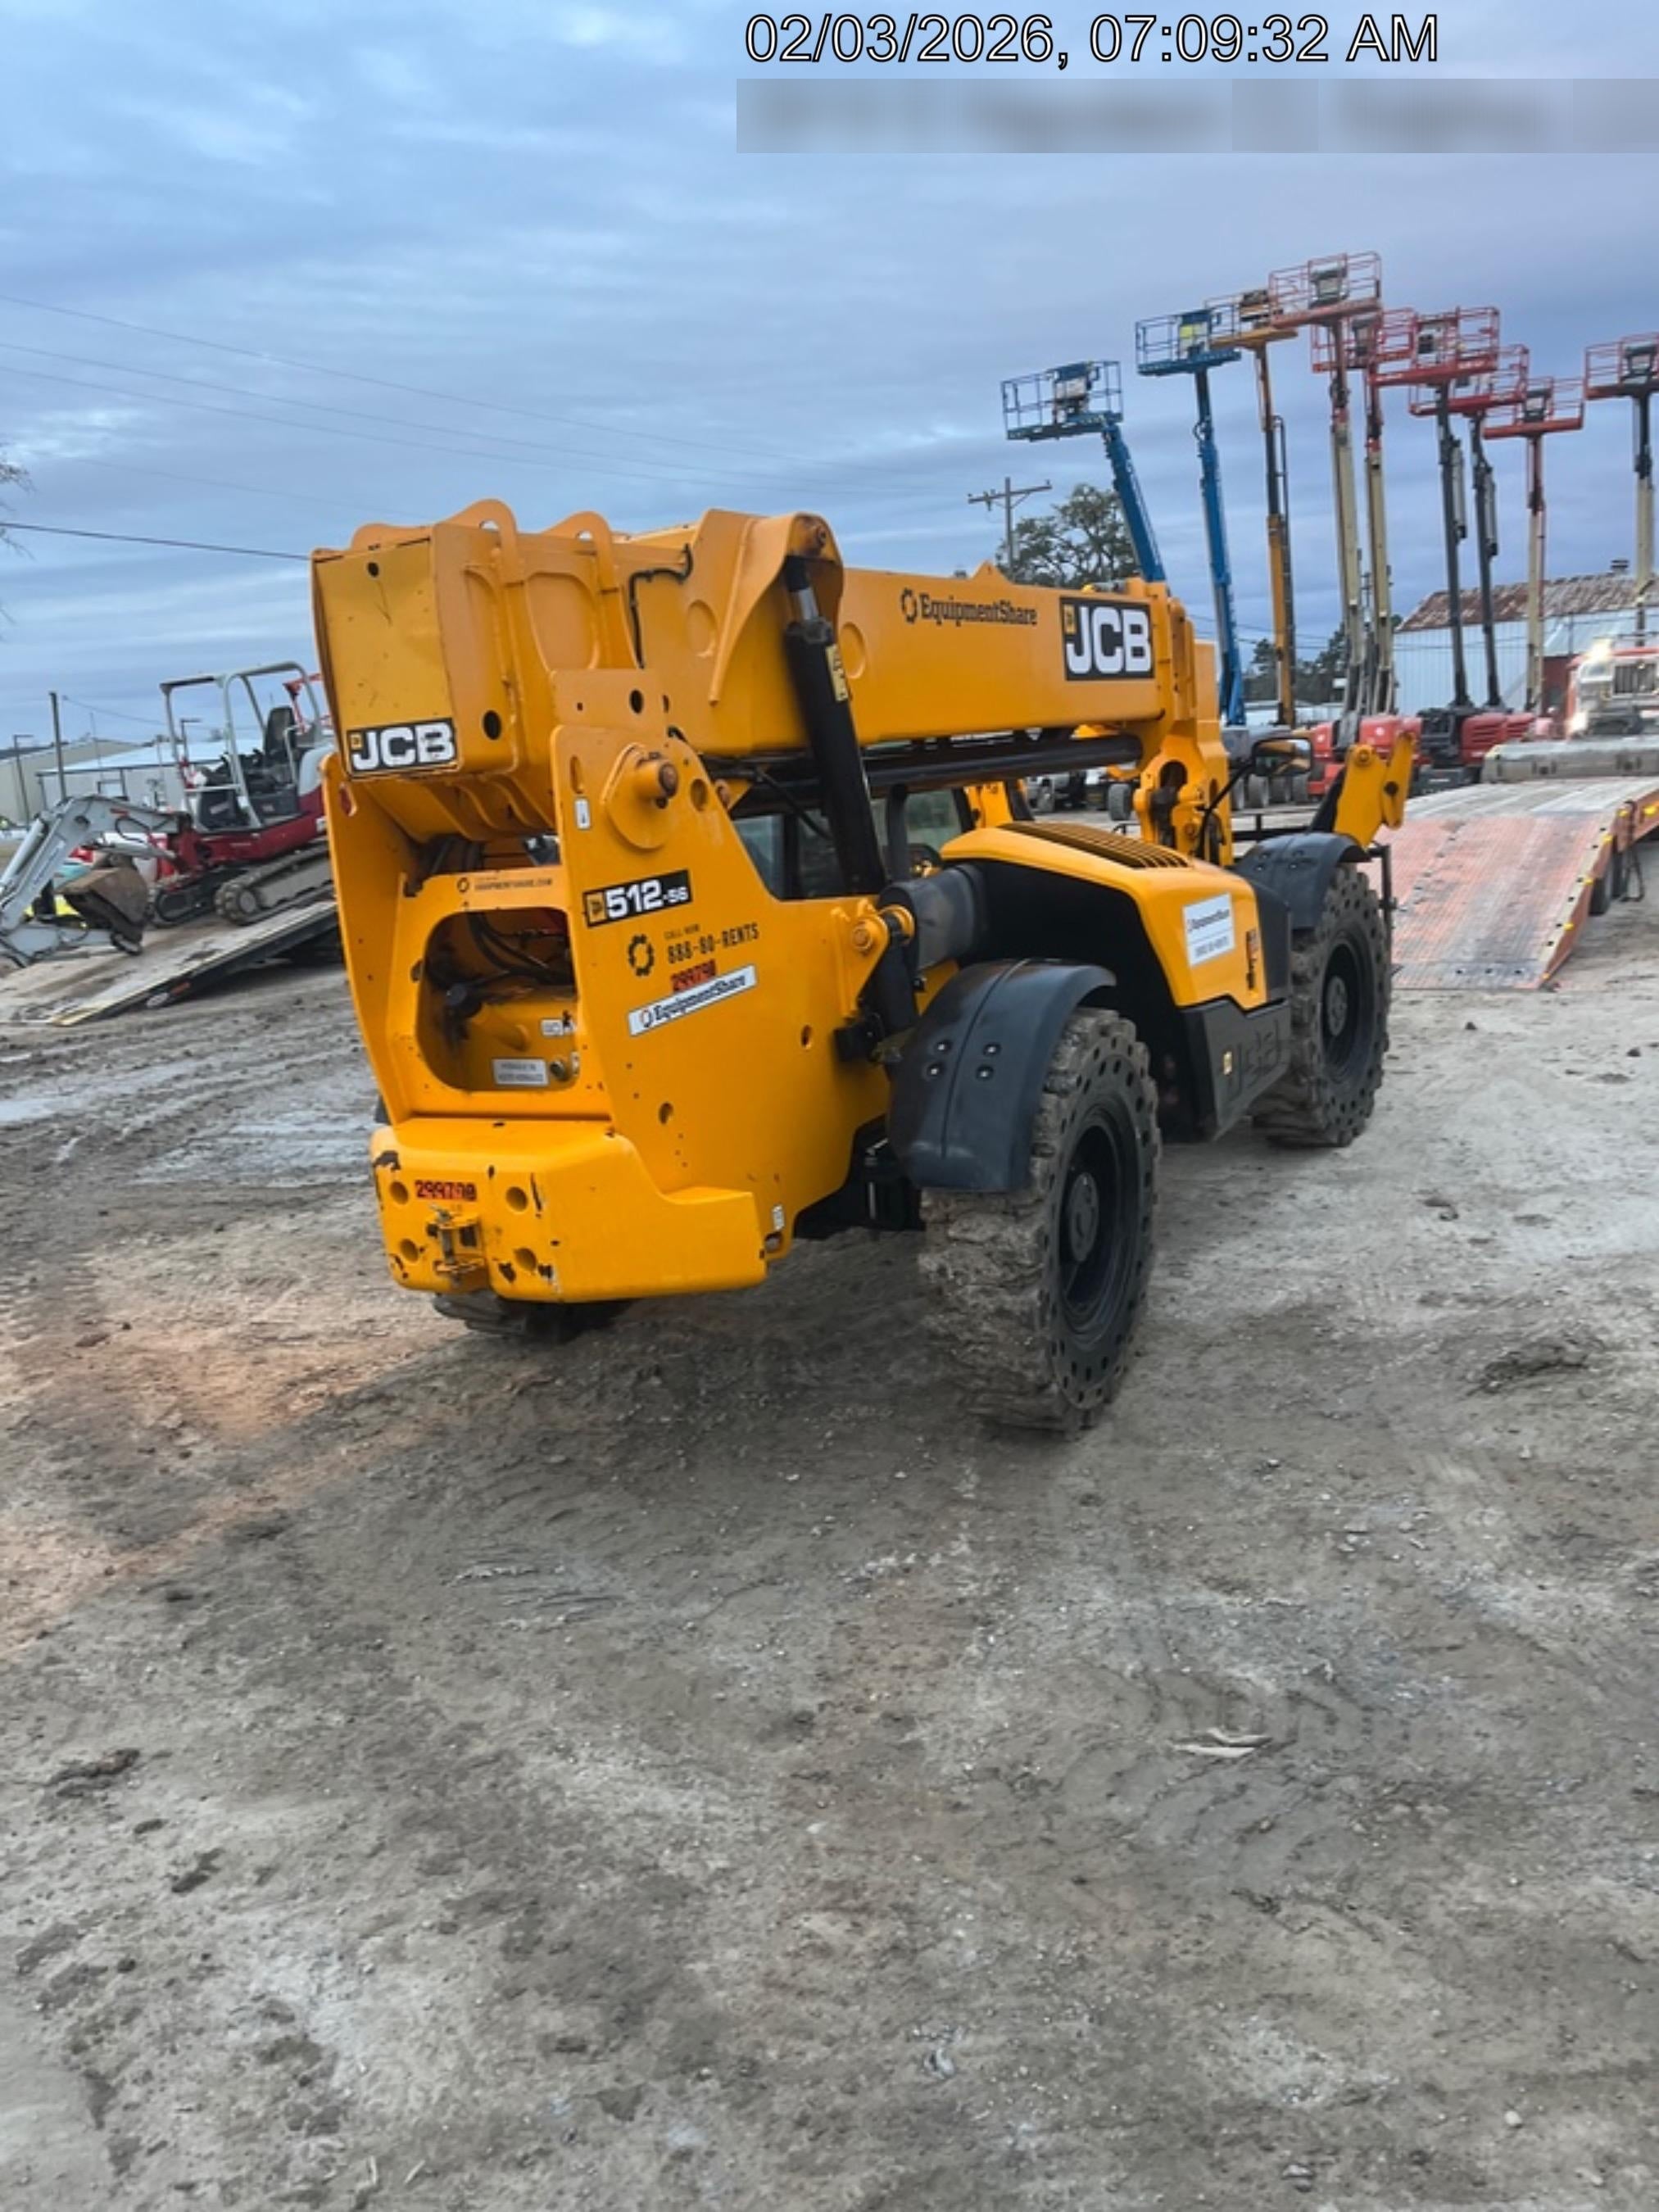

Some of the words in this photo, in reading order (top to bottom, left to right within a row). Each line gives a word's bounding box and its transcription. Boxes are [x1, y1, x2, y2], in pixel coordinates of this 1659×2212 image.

[918, 592, 1038, 627] EquipmentShare
[1066, 605, 1152, 674] JCB
[352, 722, 456, 770] JCB
[667, 921, 759, 964] 888-80-RENTS
